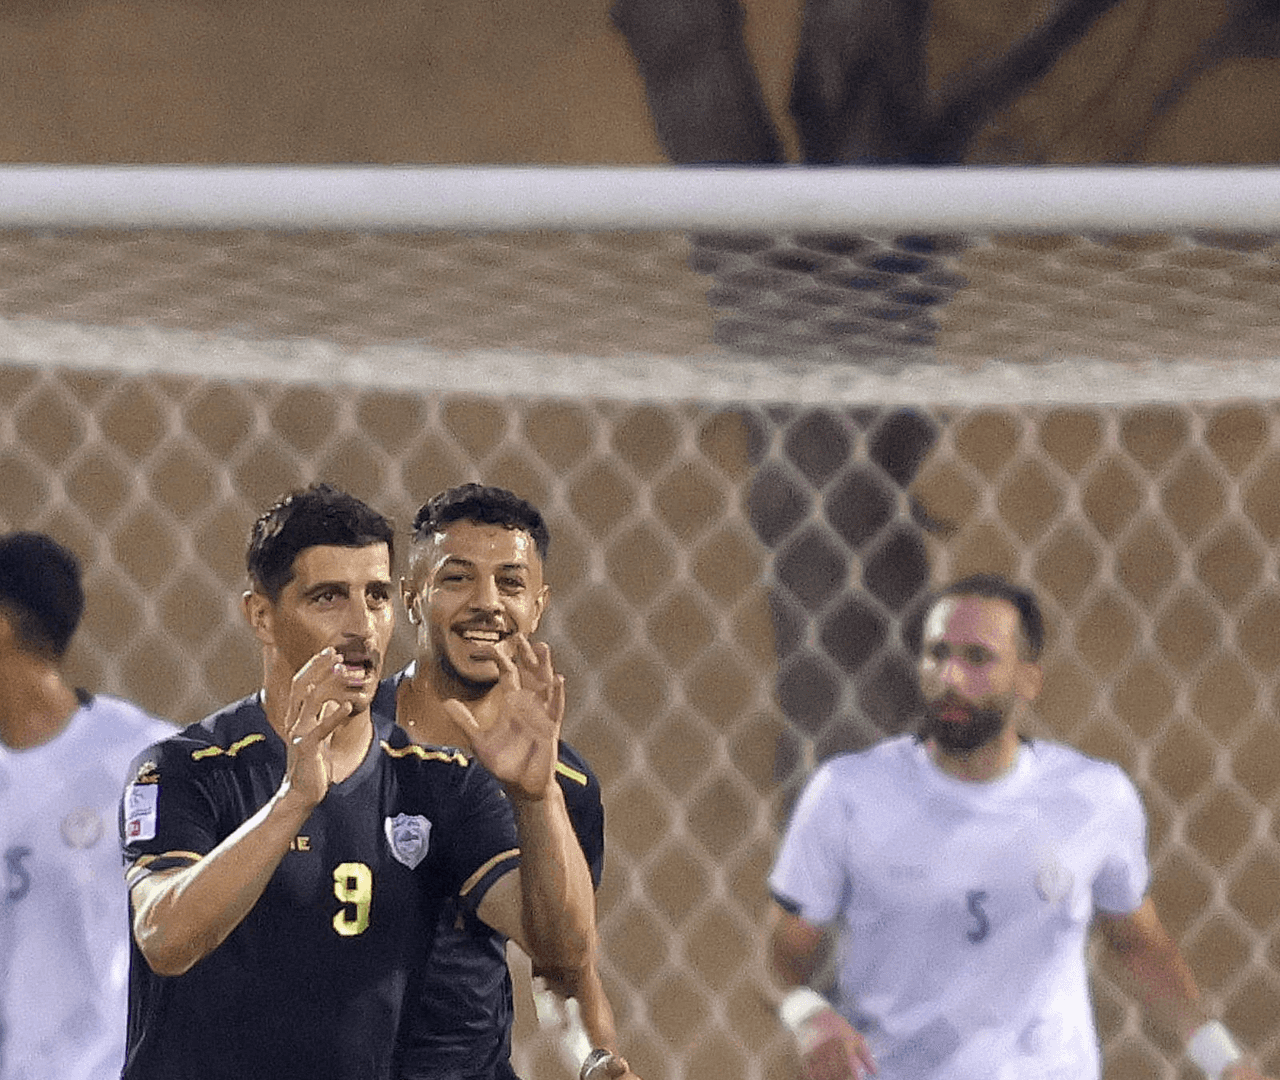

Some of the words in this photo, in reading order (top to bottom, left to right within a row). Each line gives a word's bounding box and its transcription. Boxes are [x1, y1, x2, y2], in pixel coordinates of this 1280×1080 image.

[2, 845, 34, 903] 5
[332, 862, 373, 936] 9
[965, 889, 992, 945] 5
